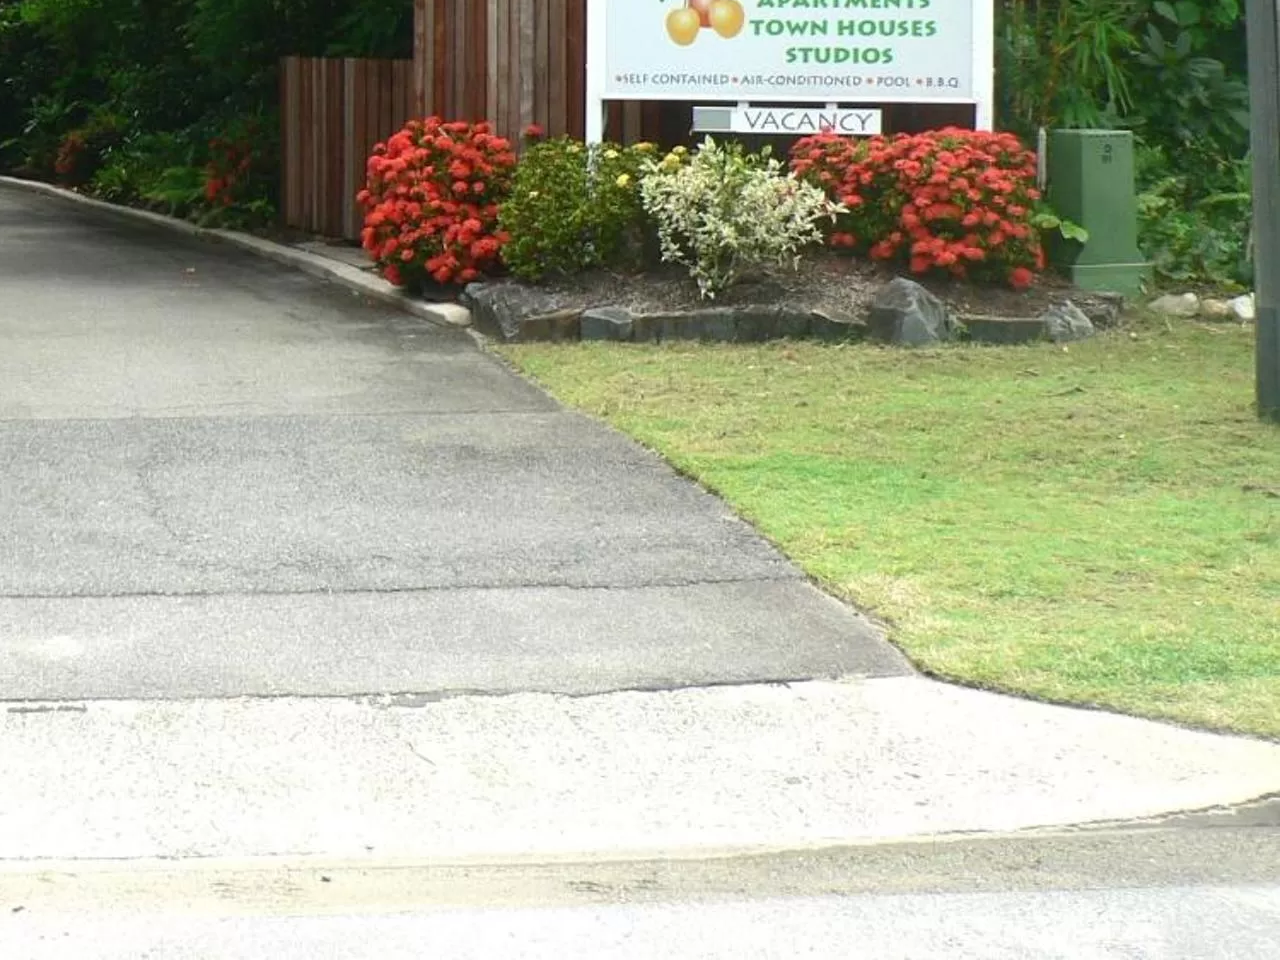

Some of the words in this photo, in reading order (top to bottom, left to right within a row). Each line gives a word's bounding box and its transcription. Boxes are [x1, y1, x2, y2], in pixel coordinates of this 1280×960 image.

[749, 19, 829, 37] TOWN
[836, 20, 937, 37] HOUSES
[785, 47, 894, 64] STUDIOS
[622, 74, 649, 84] SELF
[651, 74, 730, 85] CONTAINED
[740, 75, 862, 87] AIR-CONDITIONED
[876, 76, 911, 88] POOL
[743, 111, 874, 132] VACANCY
